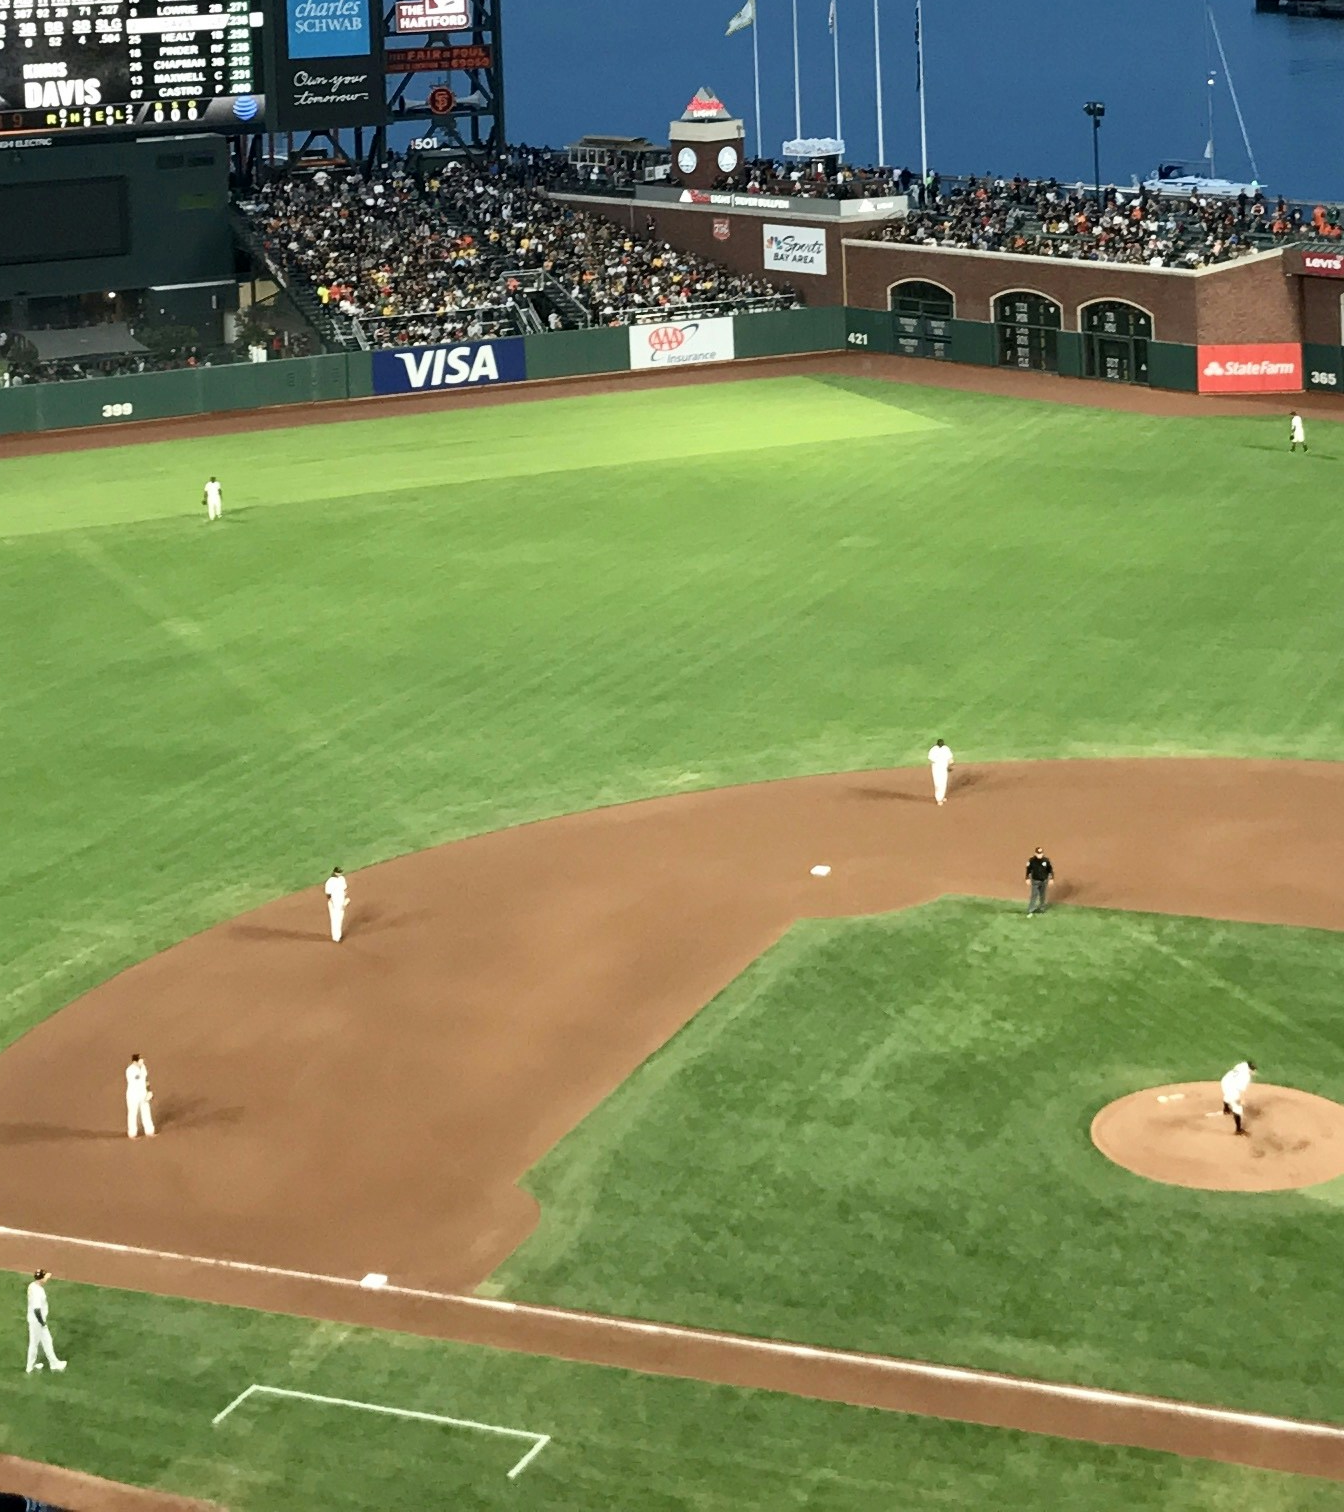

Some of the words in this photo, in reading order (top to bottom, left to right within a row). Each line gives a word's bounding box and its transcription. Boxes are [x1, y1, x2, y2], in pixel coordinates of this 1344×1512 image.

[78, 6, 91, 16] 71
[157, 5, 198, 16] LOWRIE
[399, 5, 425, 16] THE
[95, 18, 122, 30] SLG
[294, 17, 362, 34] SCHWAB
[400, 14, 467, 29] HARTFORD
[78, 35, 86, 45] 4
[161, 32, 196, 43] HEALY
[159, 45, 199, 56] PINDER
[406, 50, 441, 61] FAIR
[453, 47, 485, 58] FOUL
[153, 58, 207, 70] CHAPMAN
[154, 72, 206, 84] MAXWELL
[214, 71, 223, 80] C
[294, 70, 327, 87] Own
[327, 73, 367, 92] your
[24, 78, 102, 109] DAVIS
[158, 86, 203, 97] CASTRO
[215, 84, 224, 93] P
[126, 104, 133, 114] 2
[12, 114, 23, 129] 9
[46, 114, 57, 125] R
[70, 112, 80, 123] H
[95, 111, 104, 122] E
[115, 109, 124, 120] L
[126, 114, 133, 124] 2
[15, 138, 54, 148] ELECTRIC
[414, 138, 438, 150] 501
[782, 236, 824, 255] Sports
[773, 253, 790, 263] BAY
[792, 254, 814, 264] AREA
[650, 327, 683, 351] AAA
[847, 332, 868, 346] 421
[666, 350, 717, 364] Insurance
[394, 343, 499, 389] VISA
[1311, 370, 1338, 386] 365
[102, 402, 134, 419] 399
